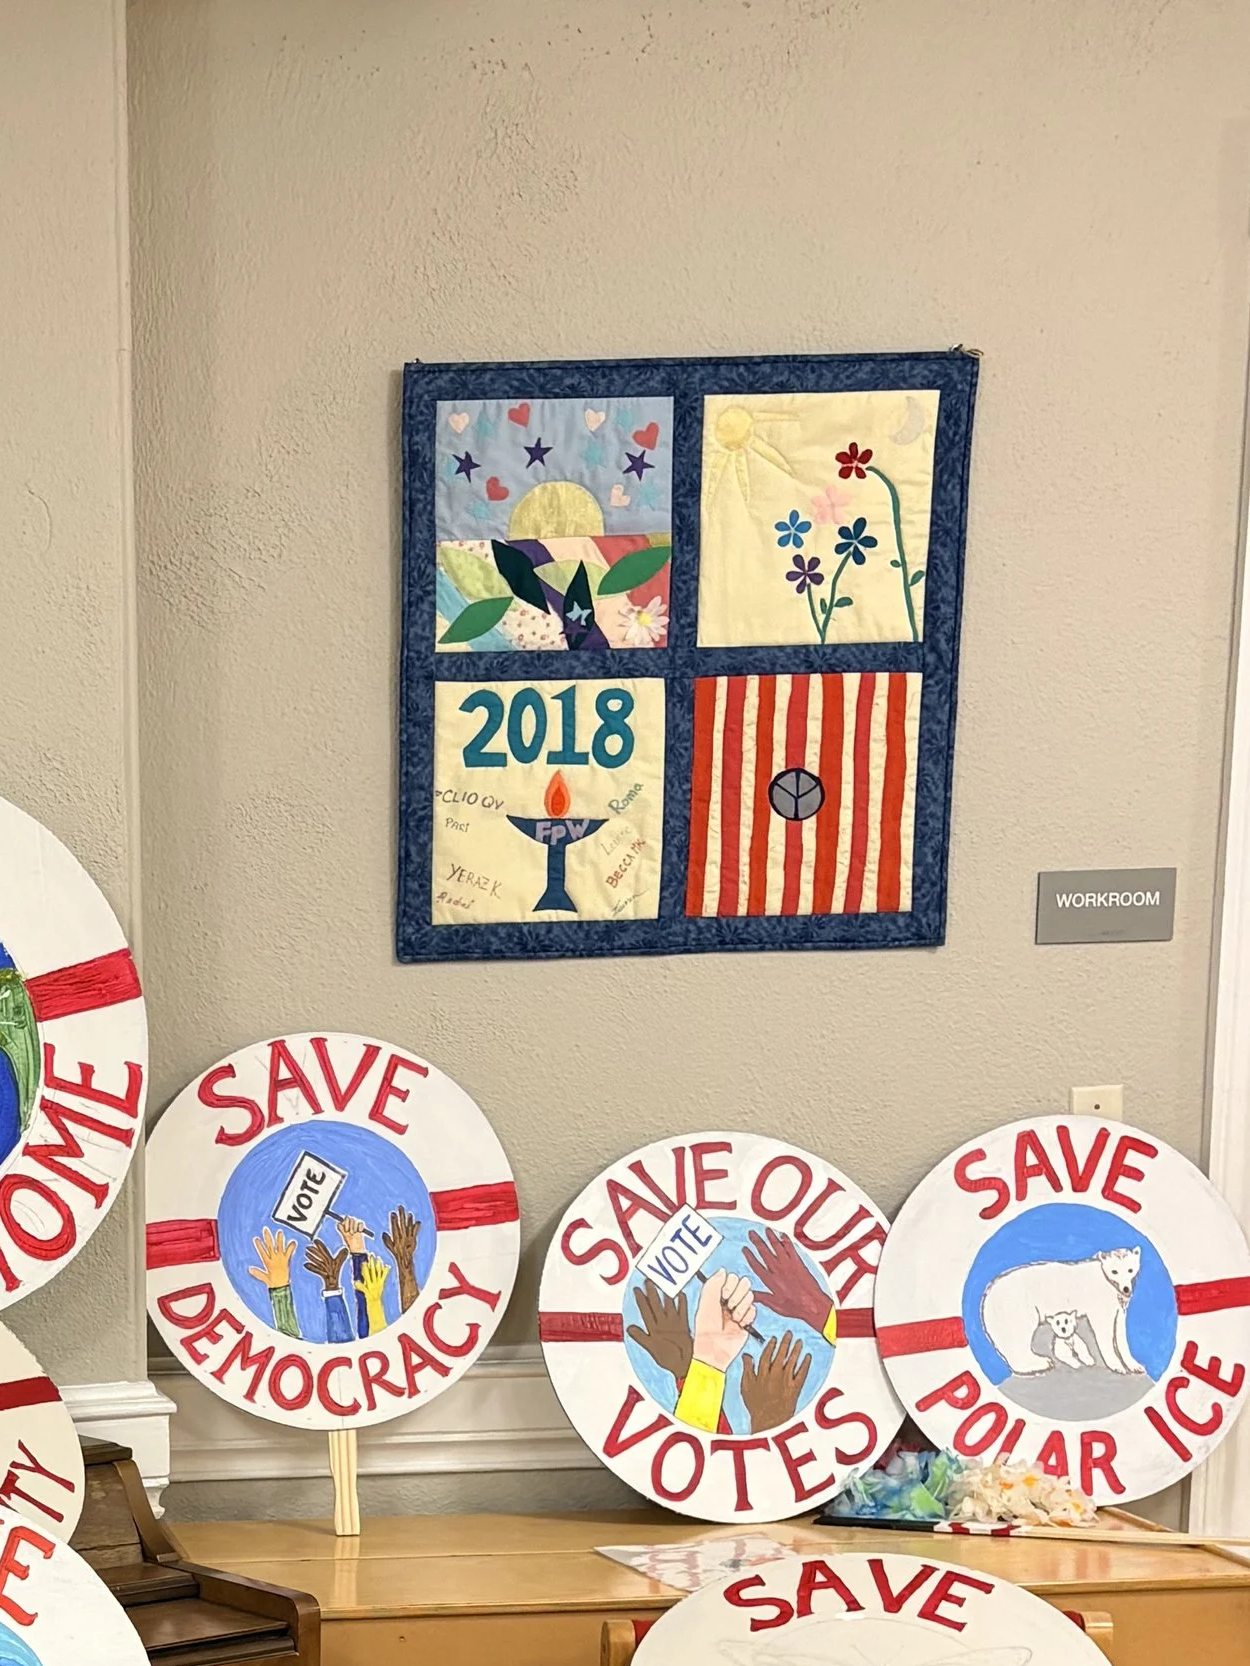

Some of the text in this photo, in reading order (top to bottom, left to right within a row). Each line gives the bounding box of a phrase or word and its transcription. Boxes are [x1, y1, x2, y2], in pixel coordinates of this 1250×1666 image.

[458, 685, 635, 768] 2018
[1056, 891, 1160, 908] WORKROOM
[198, 1037, 428, 1147] SAVE
[287, 1168, 326, 1221] VOTE
[954, 1124, 1158, 1221] SAVE
[561, 1141, 887, 1306] SAVE OUR
[647, 1214, 712, 1285] VOTE
[157, 1262, 502, 1416] DEMOCRACY
[603, 1386, 877, 1512] VOTES
[1144, 1341, 1246, 1463] ICE
[723, 1559, 994, 1632] SAVE
